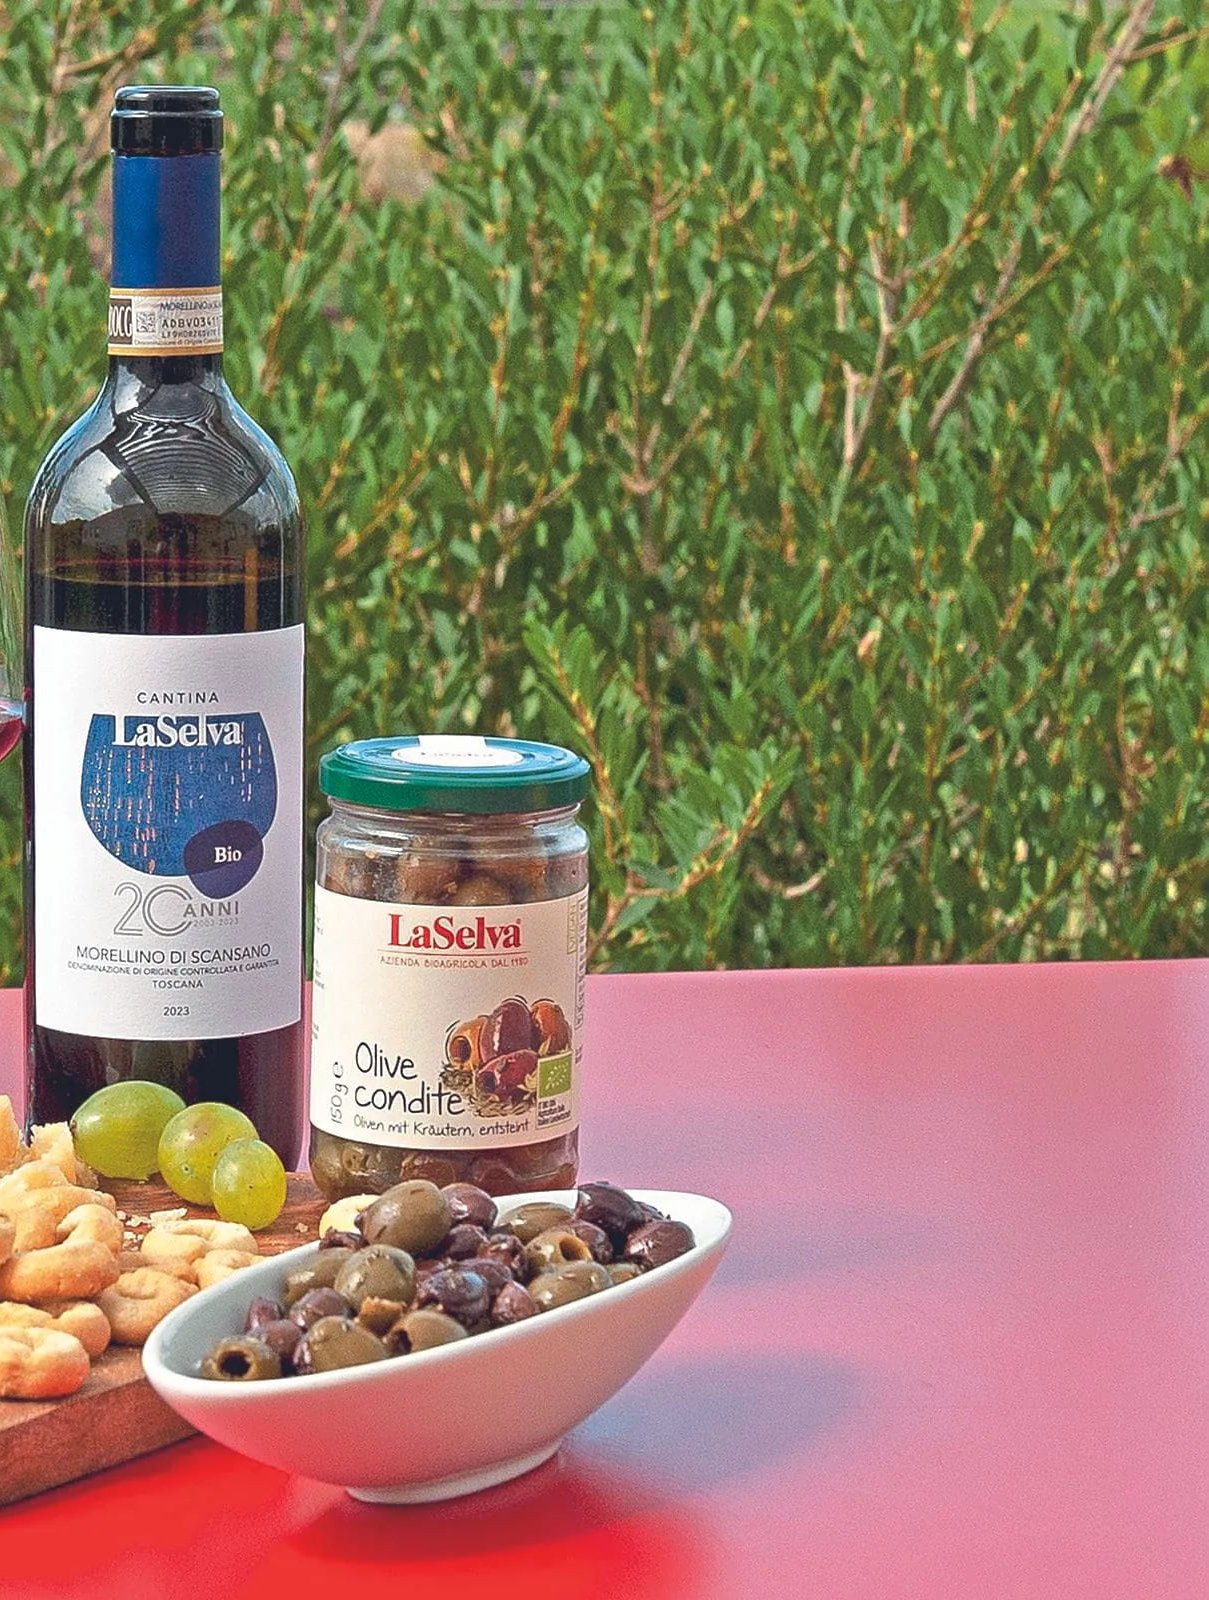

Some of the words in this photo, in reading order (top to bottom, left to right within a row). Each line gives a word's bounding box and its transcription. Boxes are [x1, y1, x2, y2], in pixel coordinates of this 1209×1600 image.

[137, 692, 219, 704] CANTINA
[112, 714, 241, 747] LaSelva
[214, 846, 242, 863] Bio
[183, 901, 239, 917] ANNI
[77, 945, 165, 964] MORELLINO
[170, 951, 186, 964] DI
[191, 943, 270, 963] SCANSANO
[68, 960, 131, 975] DENOMINAZIONE
[133, 967, 142, 975] DI
[143, 967, 179, 976] ORIGINE
[180, 965, 238, 976] CONTROLLATA
[239, 964, 244, 972] E
[380, 956, 420, 967] AZIENDA
[424, 959, 487, 969] BIOAGRICOLA
[491, 959, 509, 968] DAL
[152, 980, 203, 989] TOSCANA
[163, 1006, 189, 1017] 2023
[355, 1041, 418, 1080] Olive
[354, 1080, 465, 1116] condite
[354, 1113, 385, 1132] Oliven
[388, 1120, 409, 1135] mit
[413, 1120, 475, 1138] Kräutern,
[479, 1118, 530, 1136] entsteint
